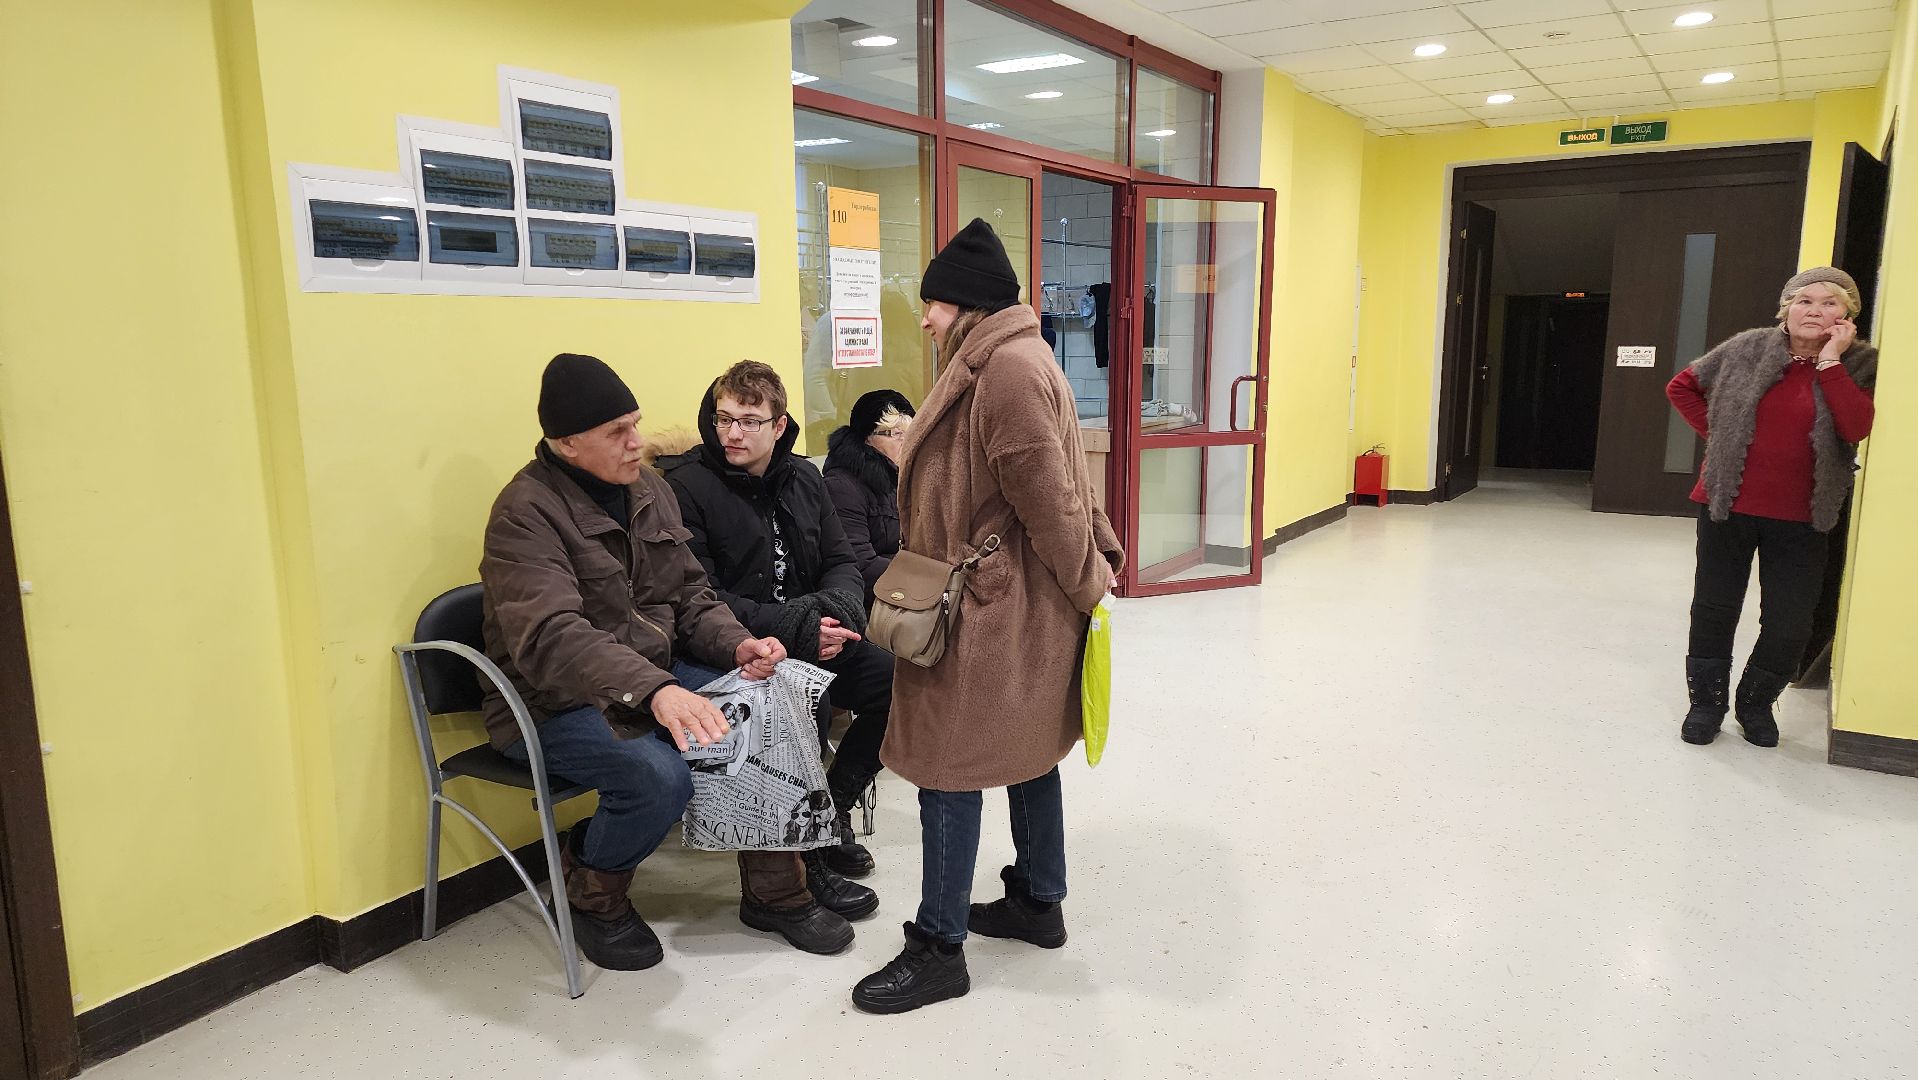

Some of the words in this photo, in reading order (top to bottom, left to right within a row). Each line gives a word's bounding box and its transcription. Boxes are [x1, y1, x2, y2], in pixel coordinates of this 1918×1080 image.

[1567, 133, 1598, 141] ВЫХОД
[1625, 125, 1652, 135] ВЫХОД
[832, 209, 847, 223] 110
[793, 663, 829, 683] amazing
[681, 745, 704, 754] our
[761, 762, 788, 782] CAUSES
[739, 802, 760, 814] Guide
[760, 809, 768, 817] to
